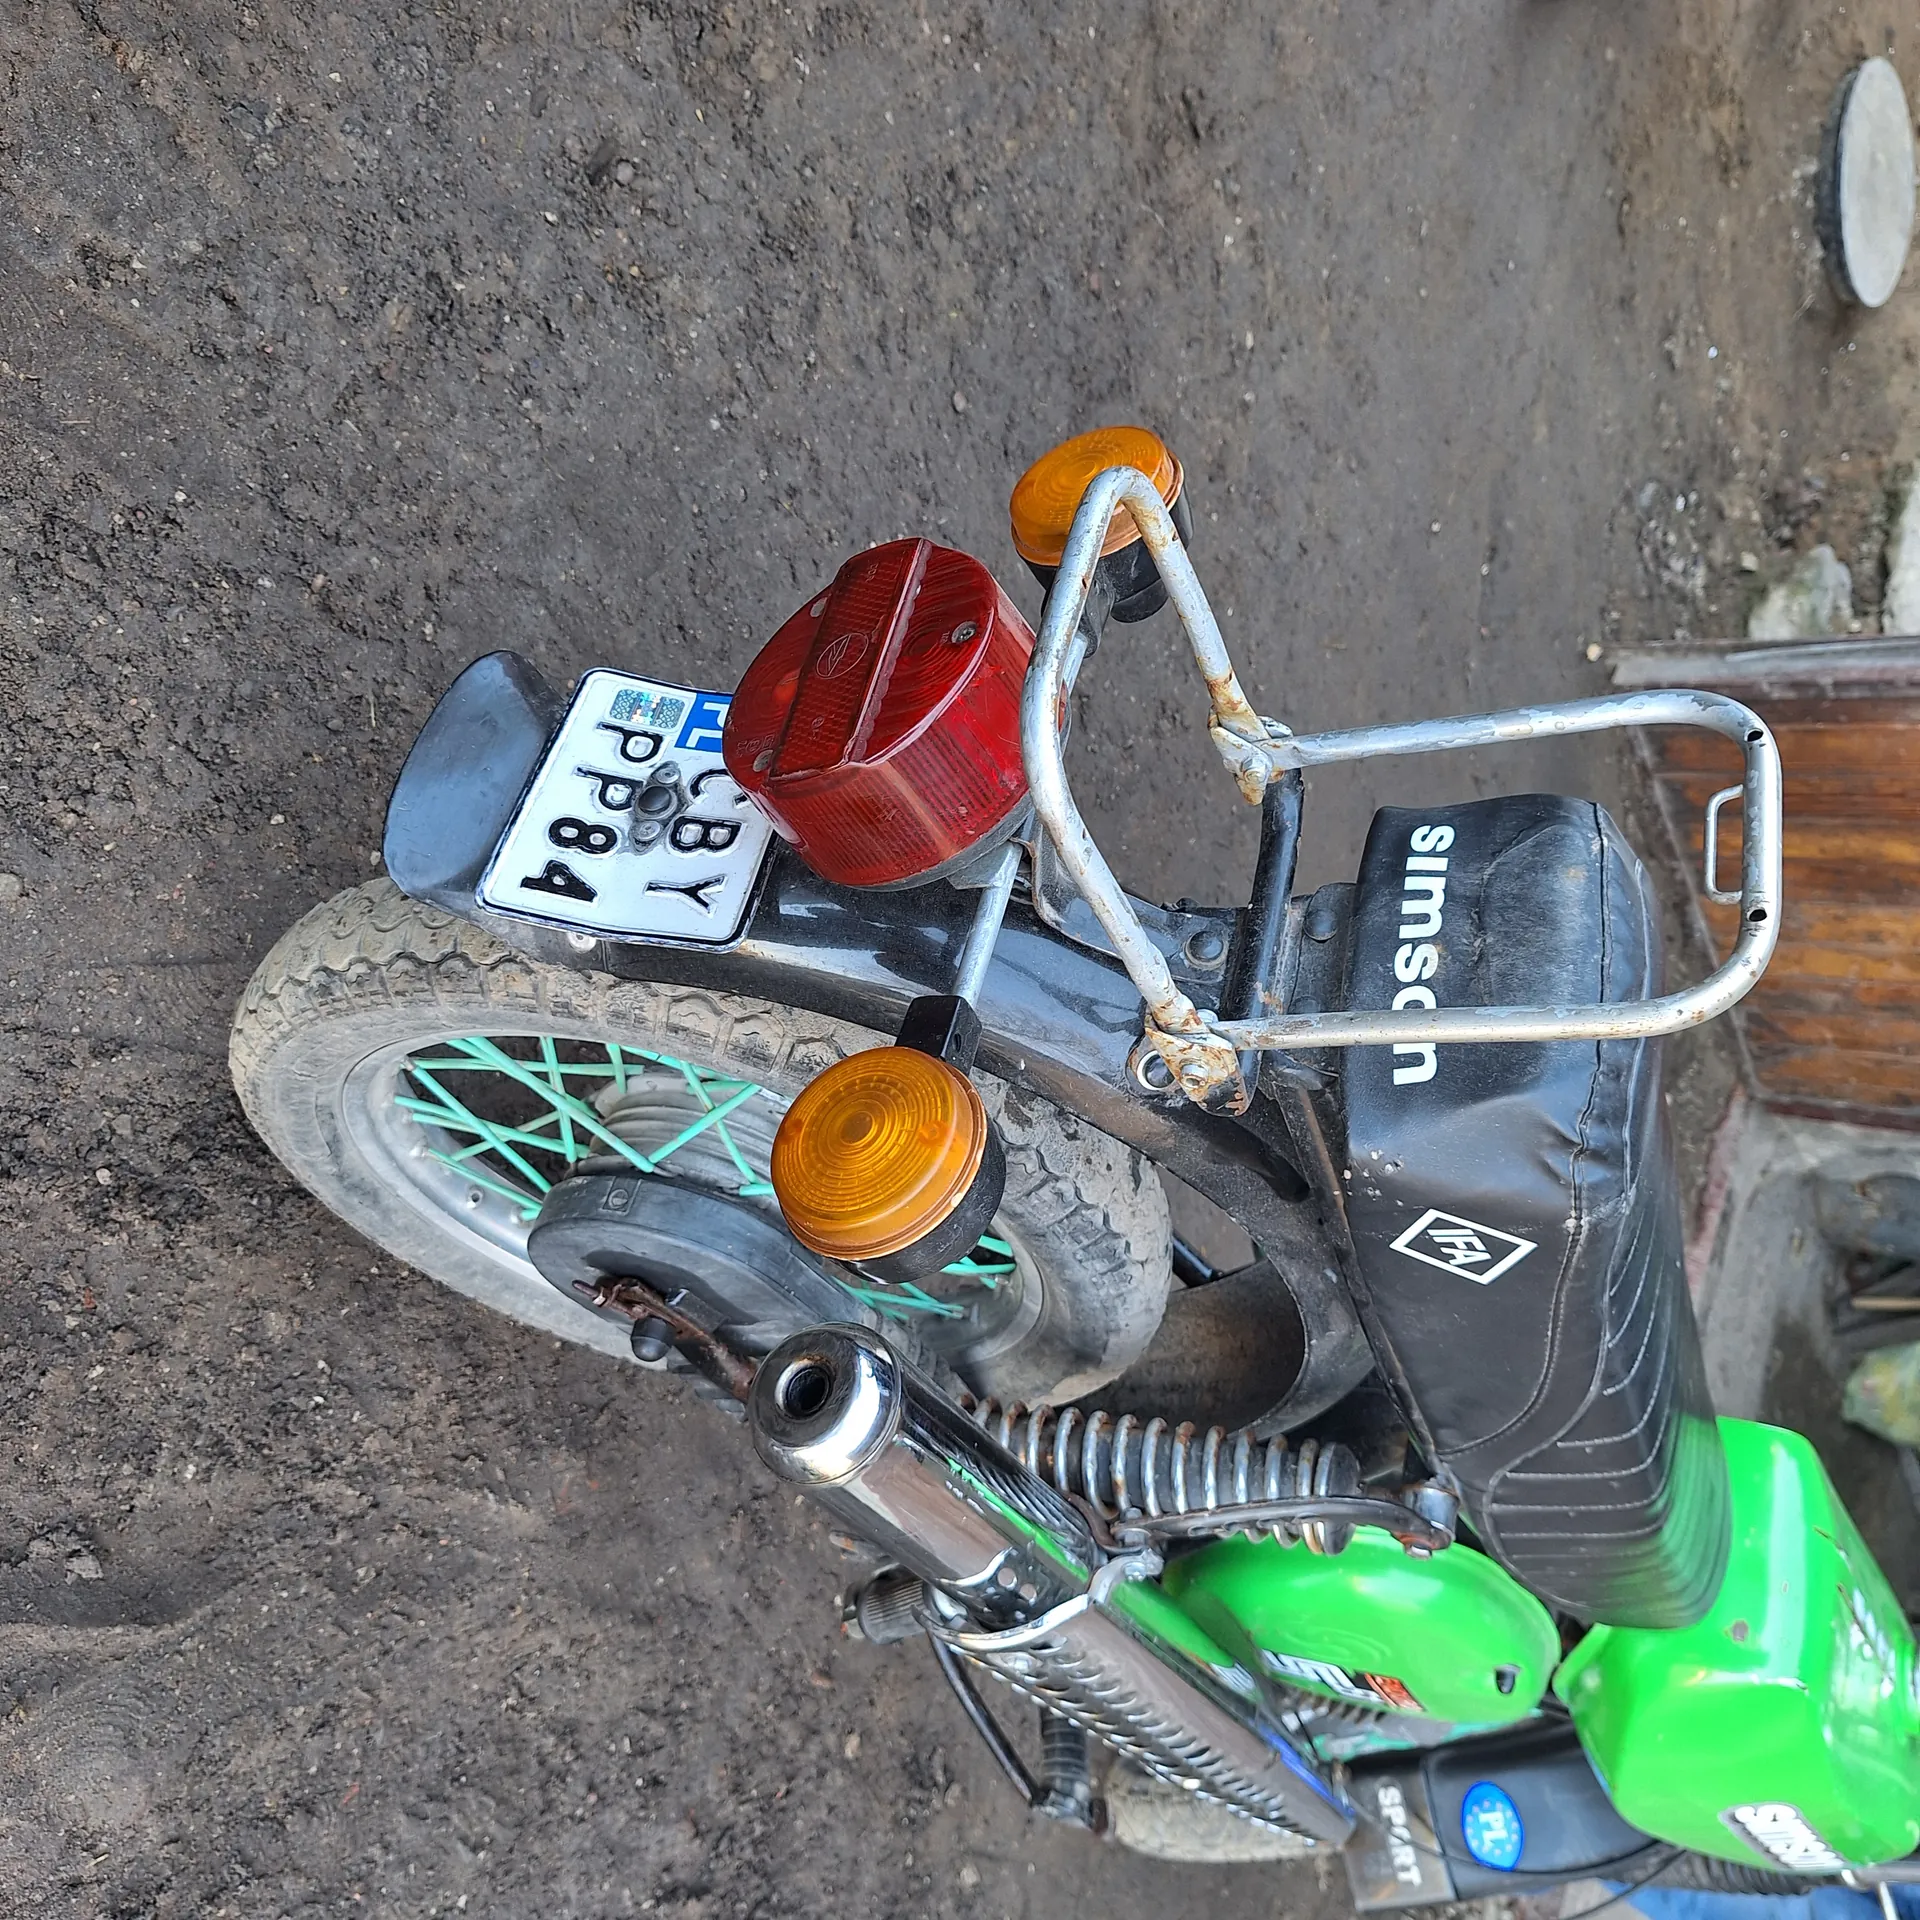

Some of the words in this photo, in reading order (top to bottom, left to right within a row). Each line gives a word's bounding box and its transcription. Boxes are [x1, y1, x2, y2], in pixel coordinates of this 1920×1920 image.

[686, 702, 731, 748] PL
[520, 723, 664, 904] PP84
[646, 768, 749, 917] CBY
[1427, 1228, 1492, 1266] IFA
[1378, 1786, 1423, 1886] SPORT
[1478, 1811, 1508, 1847] PL
